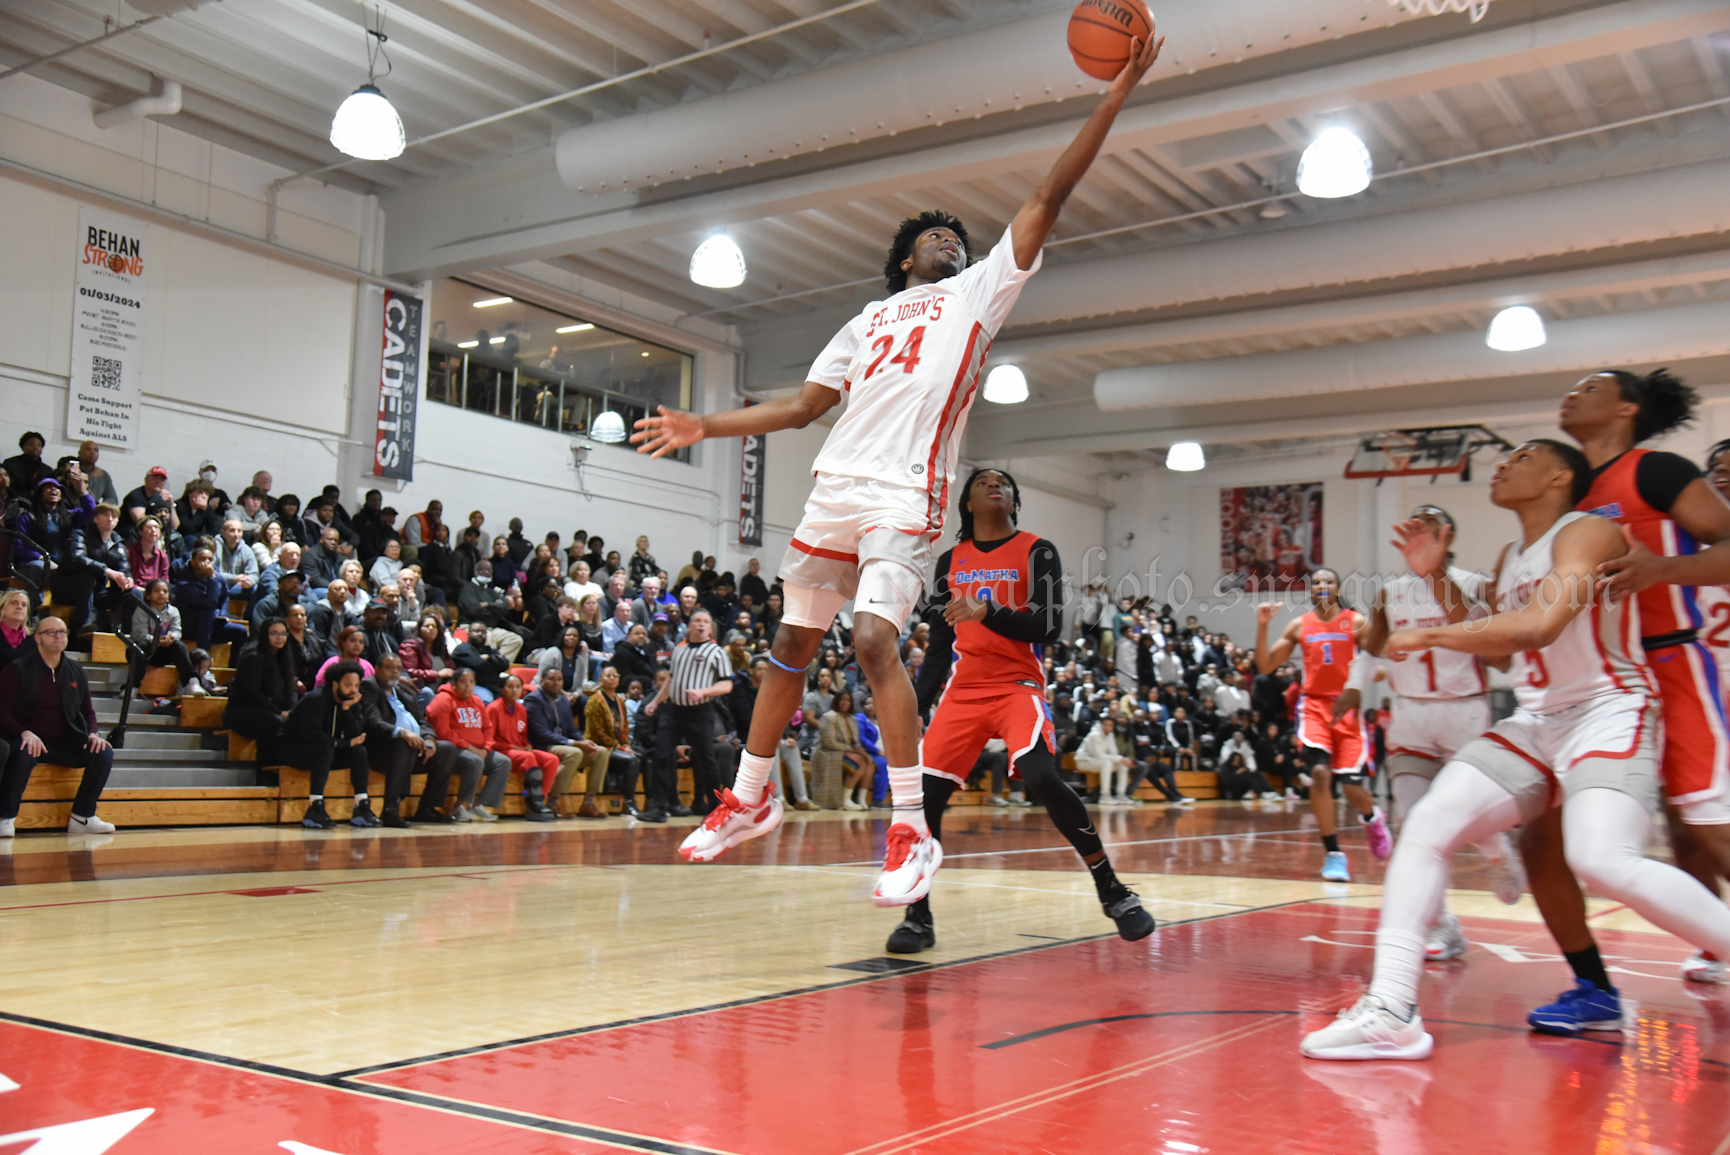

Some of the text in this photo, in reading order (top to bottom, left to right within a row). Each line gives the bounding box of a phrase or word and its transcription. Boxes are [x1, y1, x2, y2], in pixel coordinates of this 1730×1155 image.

[87, 225, 140, 258] BEHAN
[82, 242, 144, 278] STRONG
[79, 287, 141, 309] 01/03/2024
[866, 296, 945, 338] ST. JOHN'S
[864, 325, 927, 381] 24
[376, 298, 407, 468] CADETS
[401, 305, 418, 453] TEAMWORK
[78, 393, 132, 410] Come Support
[79, 405, 93, 413] Pat
[95, 408, 119, 418] Behan
[79, 428, 127, 442] Against ALS
[86, 418, 122, 430] His Fight
[740, 435, 758, 538] ADETS
[1321, 643, 1333, 665] 1
[1419, 649, 1438, 692] 1
